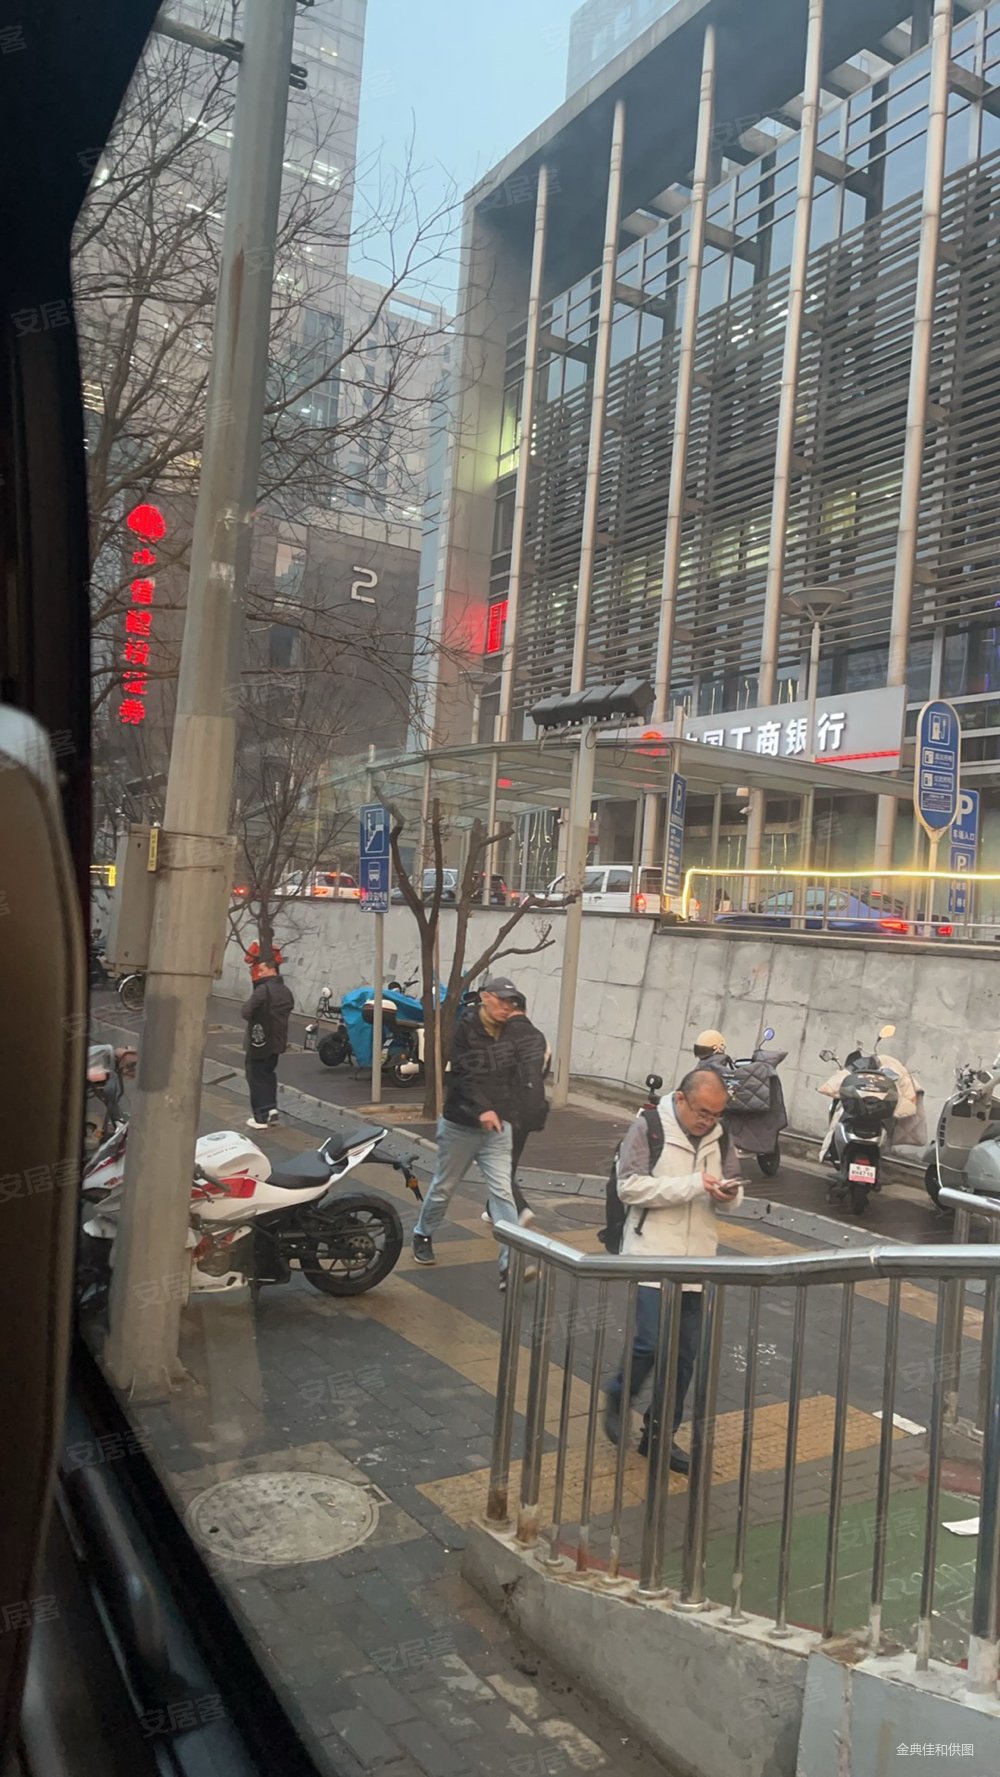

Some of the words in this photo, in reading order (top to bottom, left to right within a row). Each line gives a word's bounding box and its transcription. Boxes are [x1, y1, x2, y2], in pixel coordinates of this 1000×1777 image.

[350, 566, 378, 603] 2
[685, 711, 847, 757] 国工商银行
[956, 793, 974, 826] P
